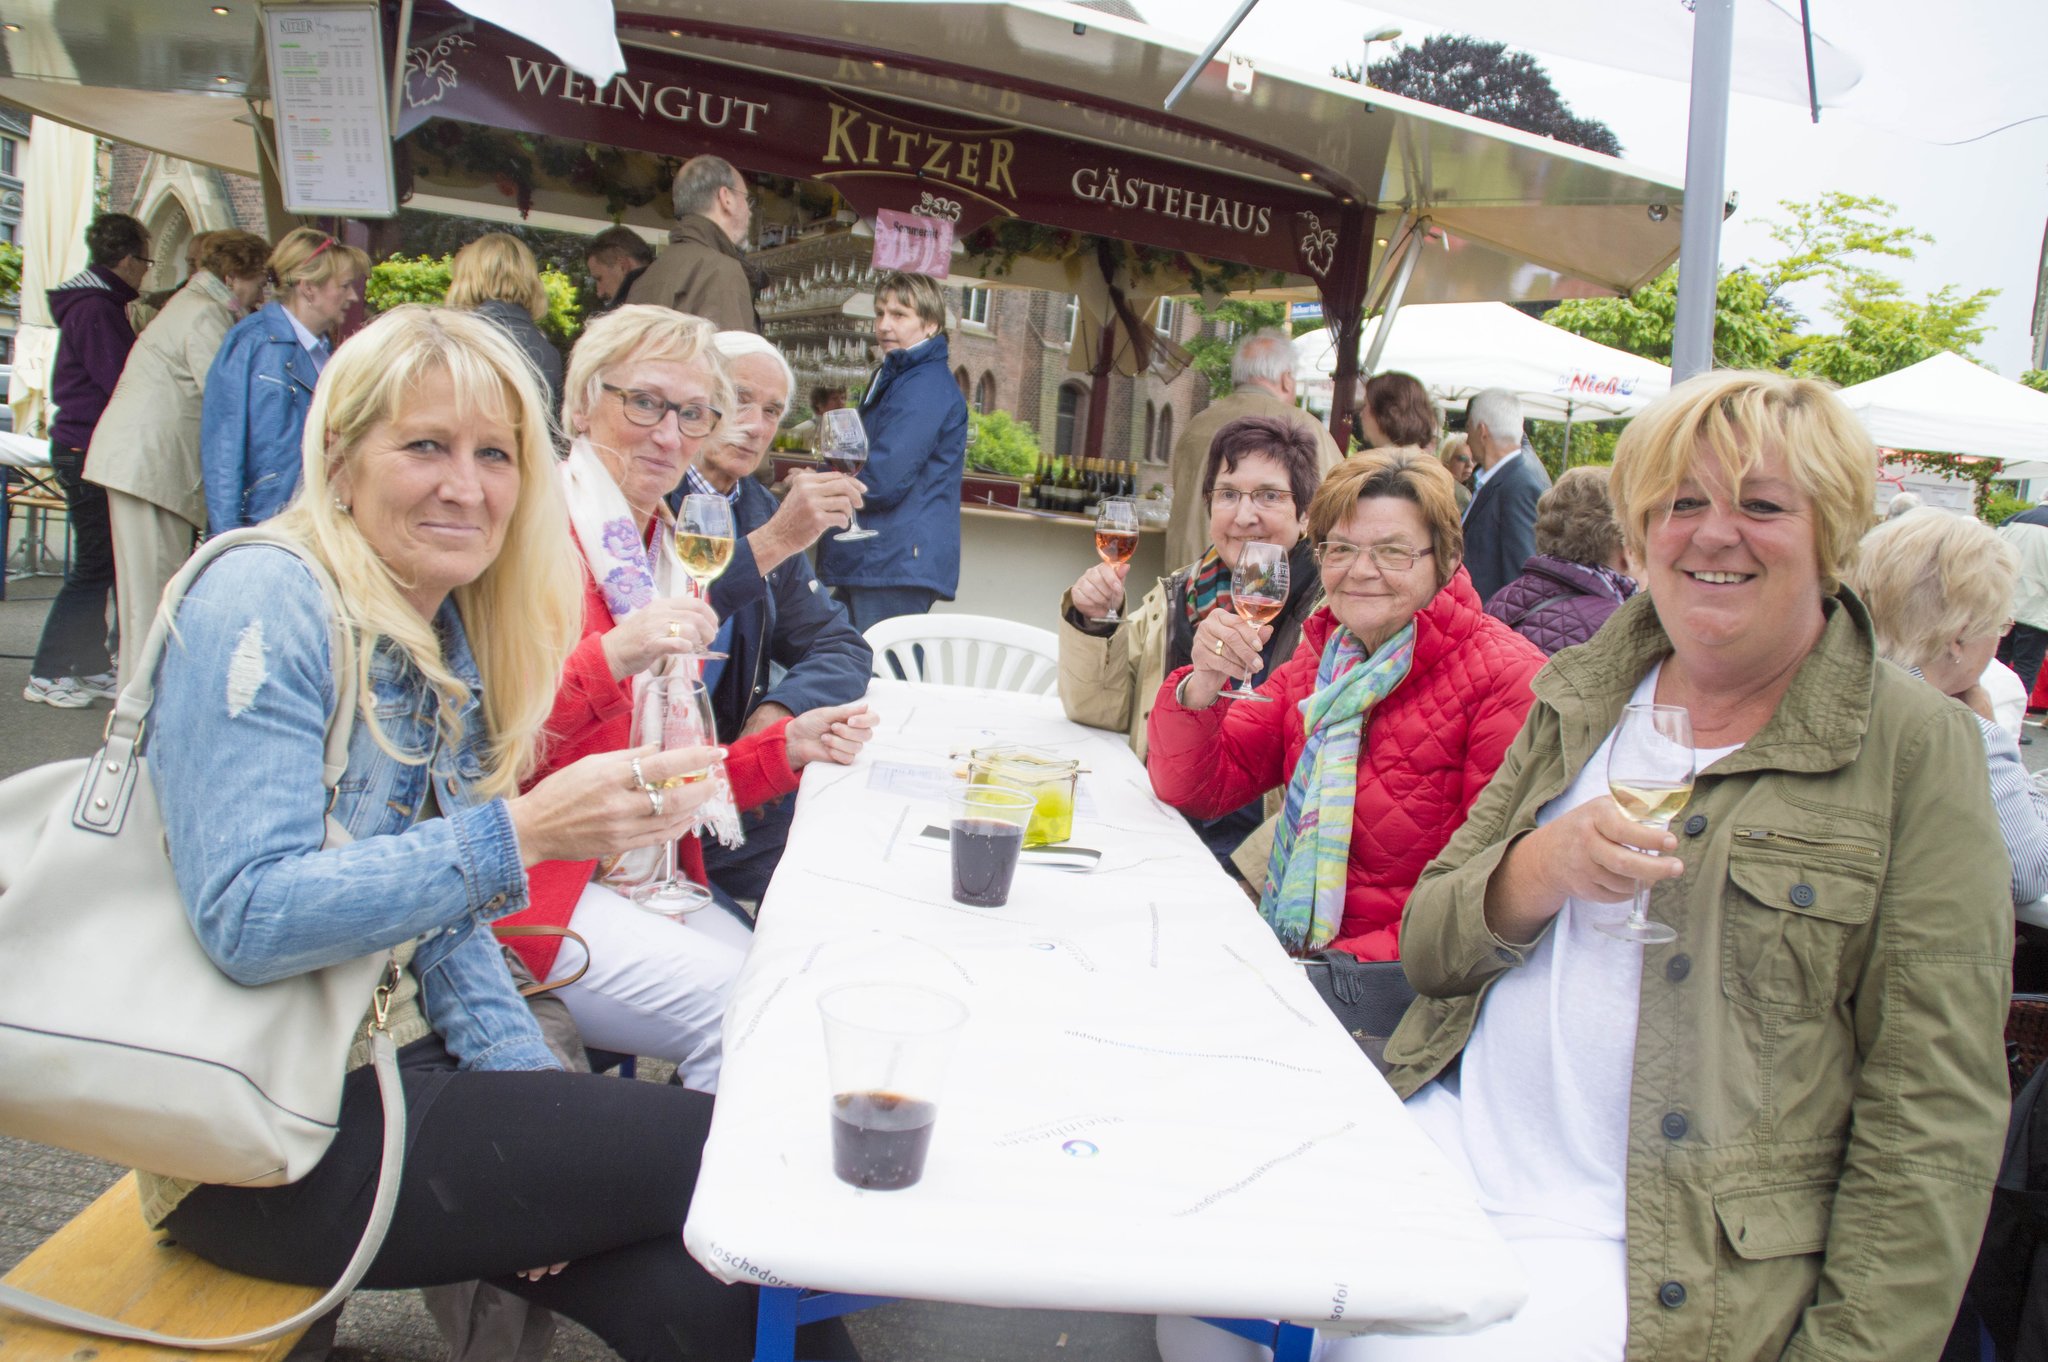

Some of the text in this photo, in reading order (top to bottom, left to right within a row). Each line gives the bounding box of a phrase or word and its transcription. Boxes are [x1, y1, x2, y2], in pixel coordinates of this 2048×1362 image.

[505, 55, 769, 134] WEINGUT
[822, 102, 1017, 198] KITZER
[1071, 167, 1272, 235] GÄSTEHAUS
